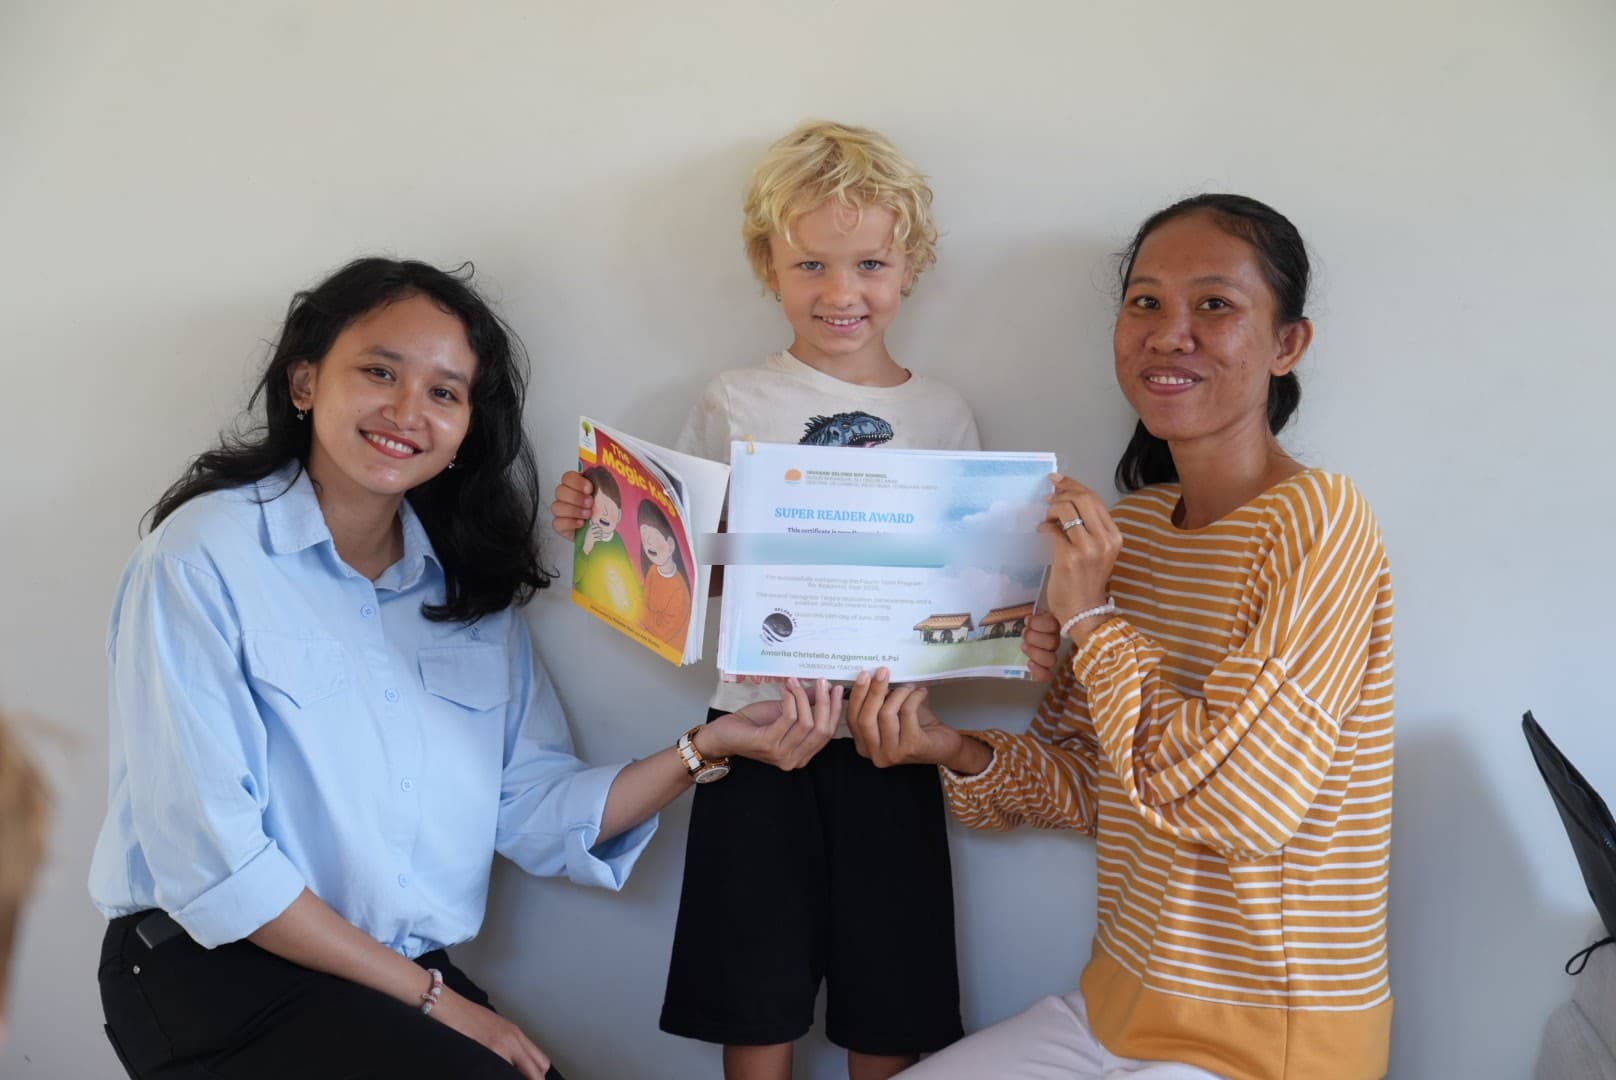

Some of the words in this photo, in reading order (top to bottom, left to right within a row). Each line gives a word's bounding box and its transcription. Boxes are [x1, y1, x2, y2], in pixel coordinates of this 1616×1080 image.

[602, 448, 648, 491] Magic
[774, 507, 815, 520] SUPER
[817, 509, 867, 523] READER
[868, 511, 915, 524] AWARD
